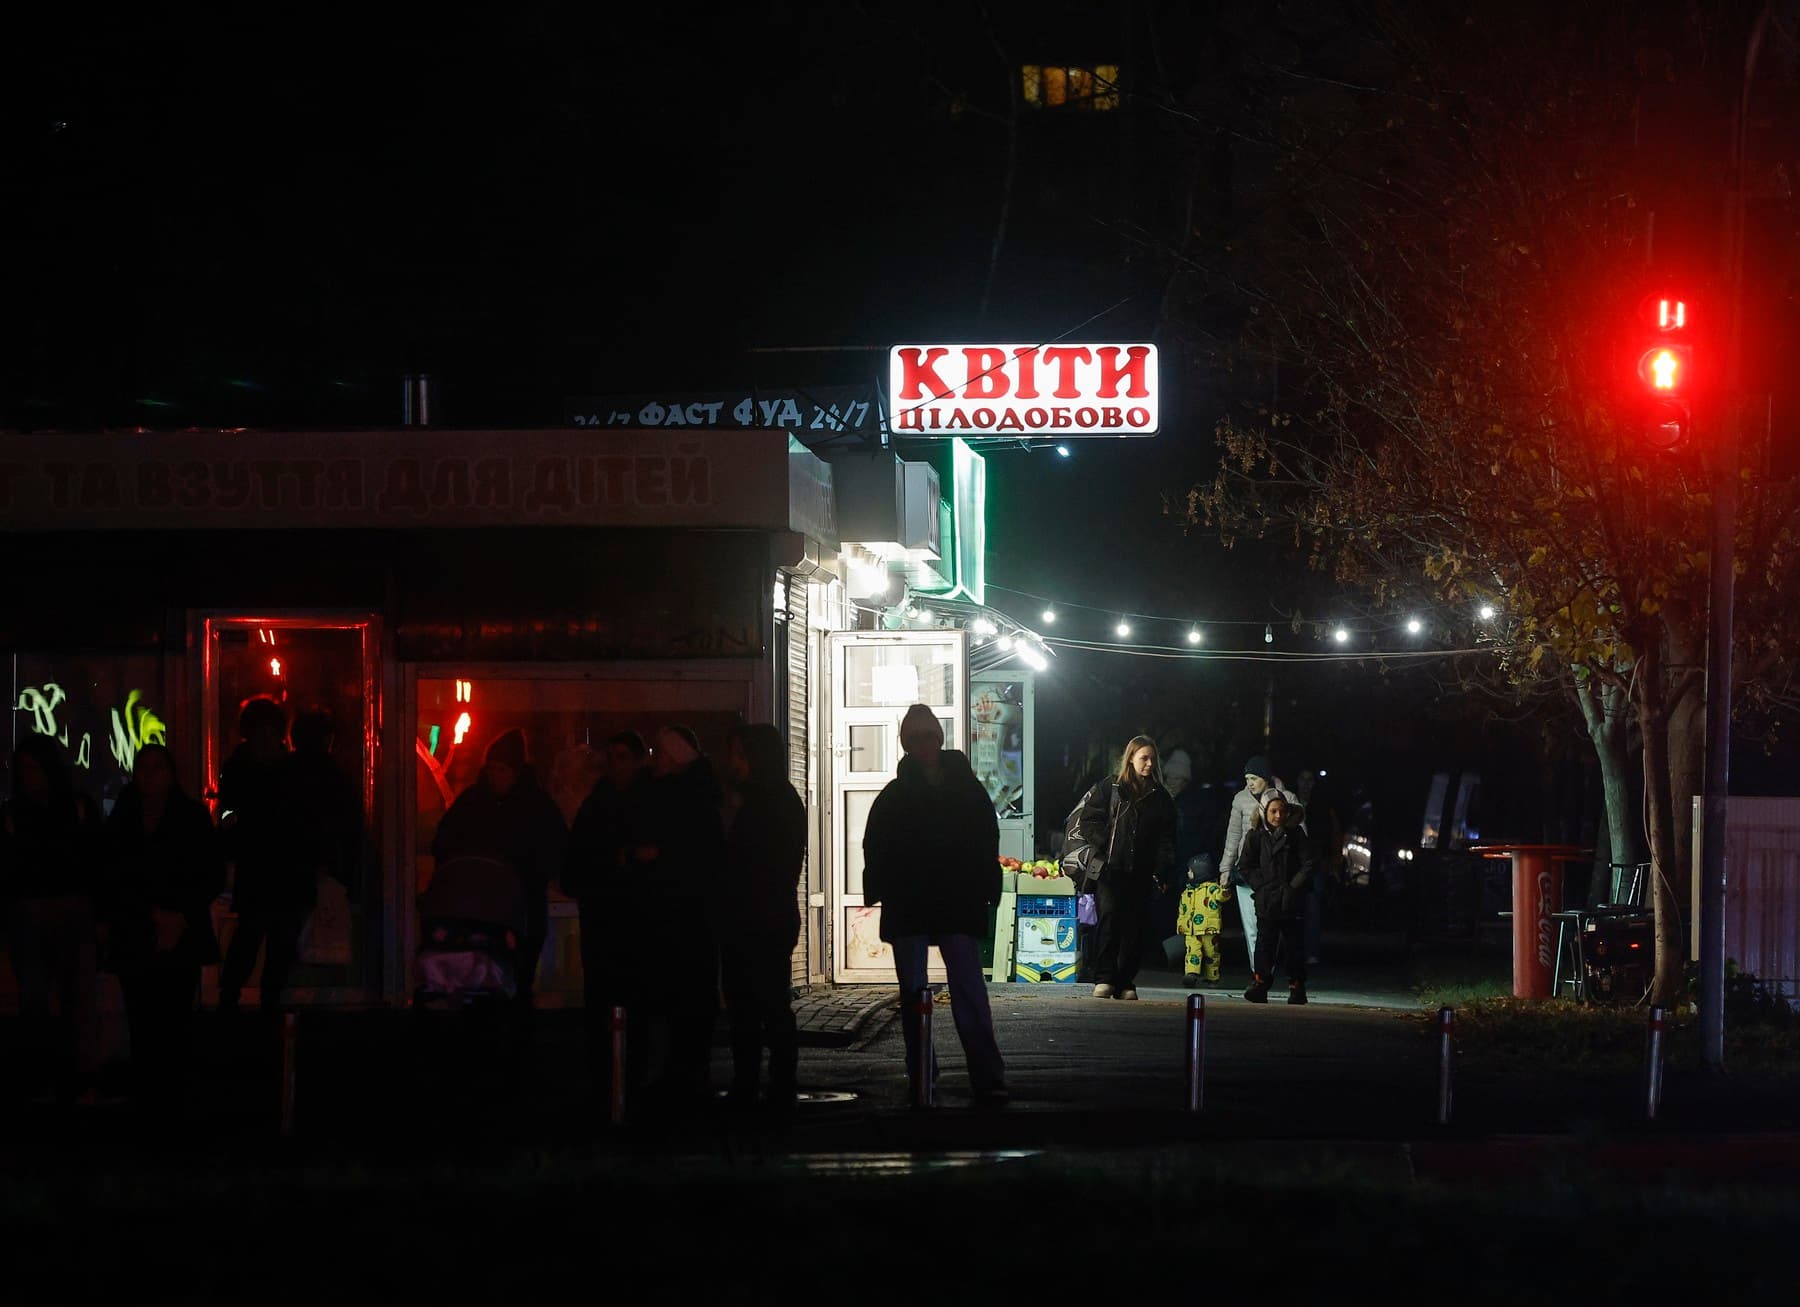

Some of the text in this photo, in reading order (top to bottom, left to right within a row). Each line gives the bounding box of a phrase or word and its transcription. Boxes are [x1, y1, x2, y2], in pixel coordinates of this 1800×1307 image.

[898, 346, 1150, 399] КВІТИ
[638, 401, 724, 427] ФАСТ
[733, 397, 802, 427] ФУД
[809, 399, 870, 431] 24/7
[898, 406, 1150, 431] ЦІЛОДОБОВО
[40, 458, 122, 512] ТА
[136, 457, 367, 512] ВЗУТТЯ
[376, 456, 510, 518] ДЛЯ
[523, 442, 711, 516] ДІТЕЙ
